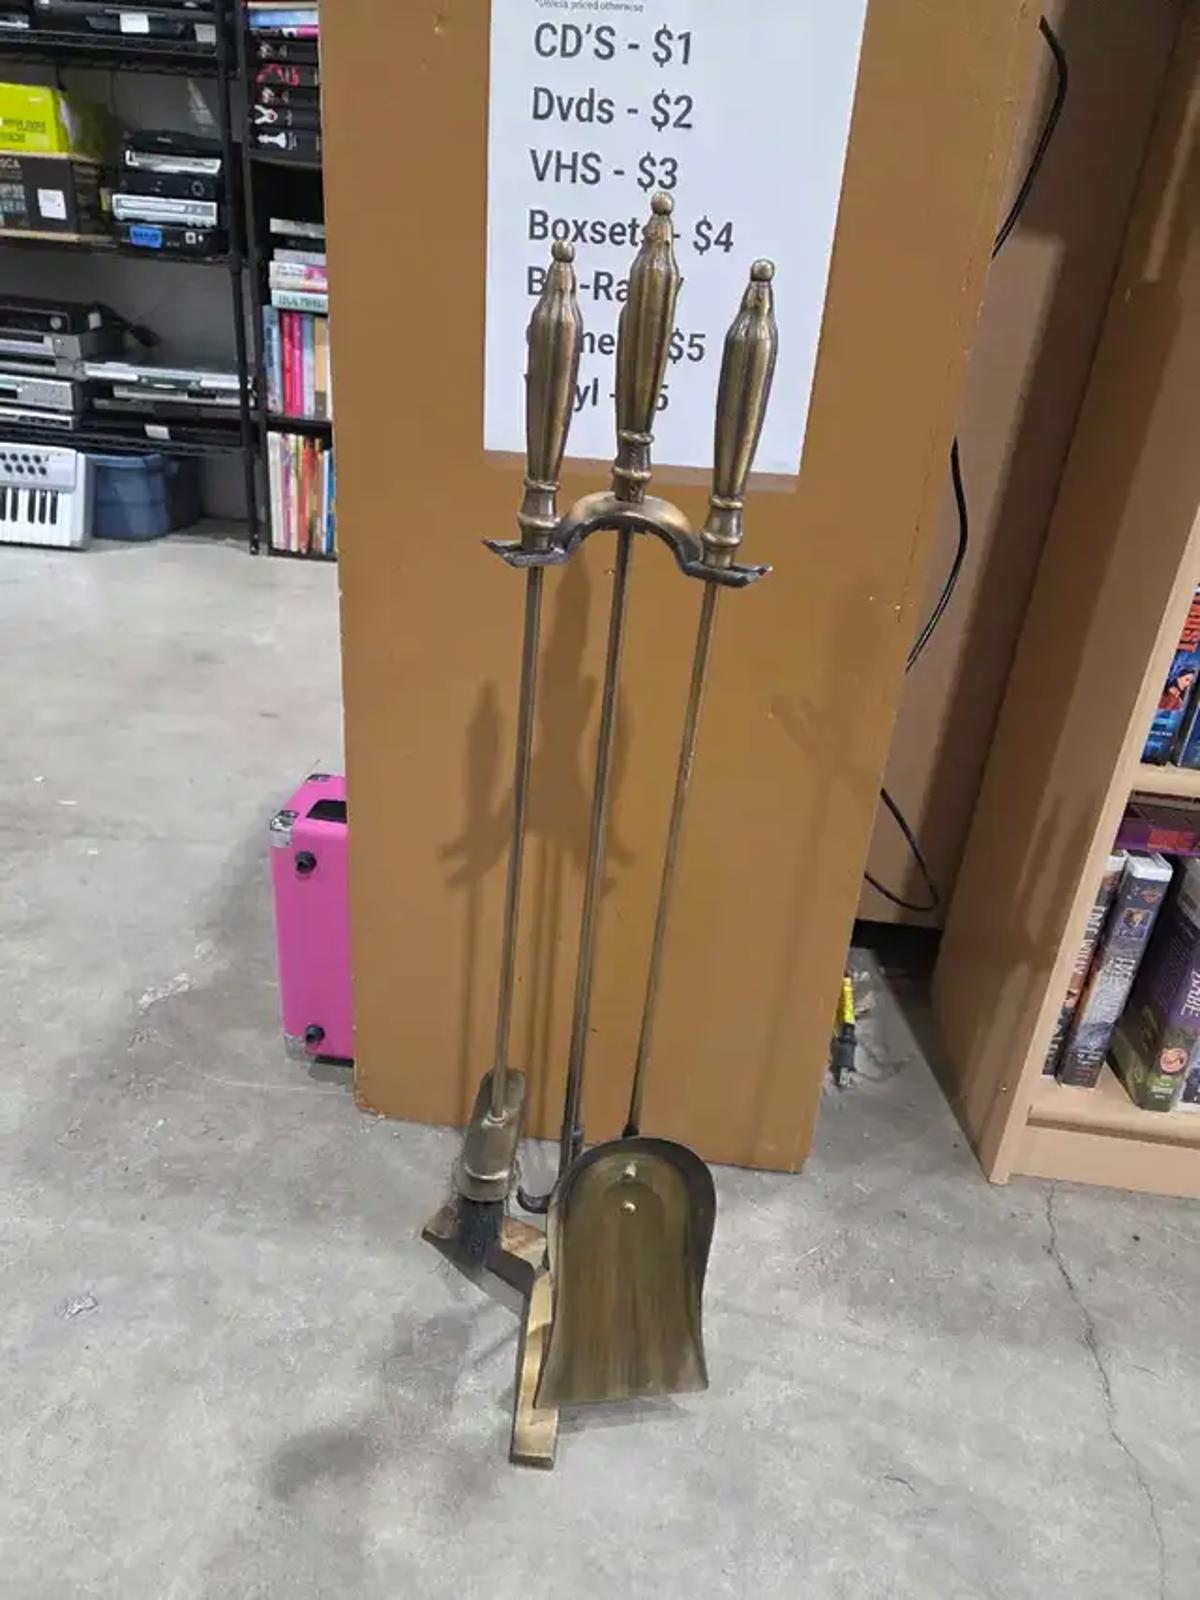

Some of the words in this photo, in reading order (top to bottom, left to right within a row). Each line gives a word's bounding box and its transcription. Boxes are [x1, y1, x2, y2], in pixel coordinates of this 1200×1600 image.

[652, 24, 691, 67] $1
[532, 86, 615, 124] Dvds
[651, 89, 693, 132] $2
[530, 149, 602, 185] VHS
[637, 152, 678, 191] $3
[528, 209, 646, 247] Boxset
[693, 216, 734, 255] $4
[527, 266, 684, 303] B-Ra
[668, 328, 706, 364] $5
